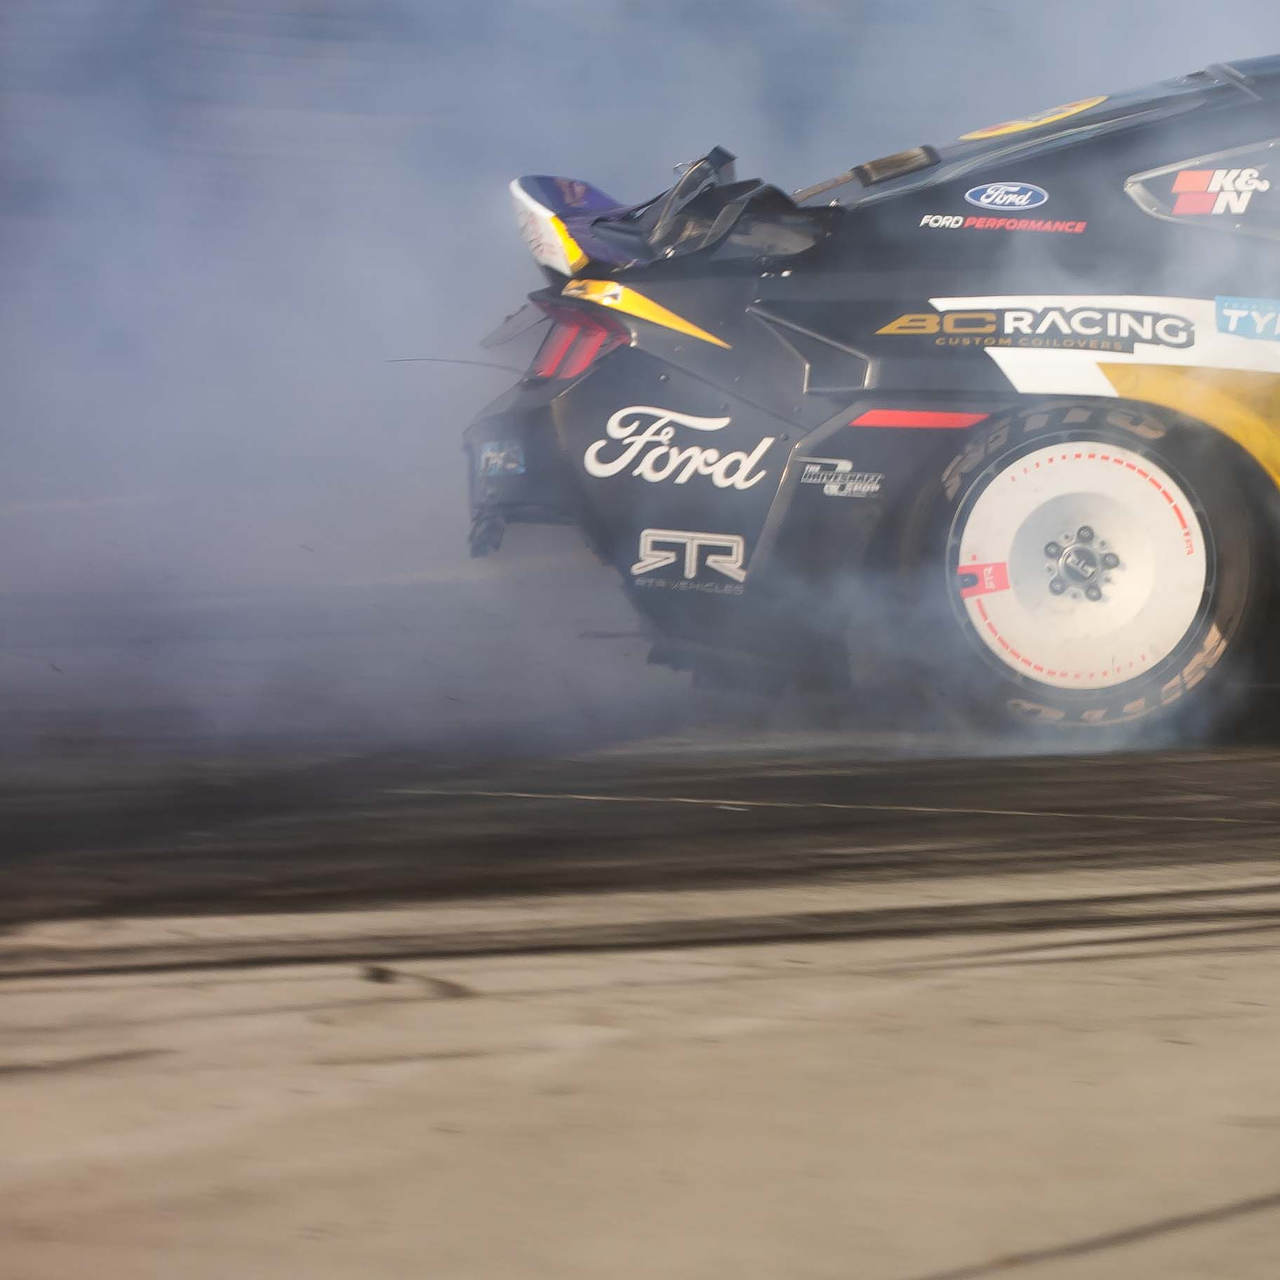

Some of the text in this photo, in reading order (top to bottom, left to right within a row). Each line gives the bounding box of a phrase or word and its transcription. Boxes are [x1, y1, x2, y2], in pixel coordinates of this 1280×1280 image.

[980, 185, 1034, 207] Ford
[919, 214, 1088, 234] FORD PERFORMANCE
[1003, 311, 1189, 344] RACING
[935, 336, 1012, 347] CUSTOM
[584, 405, 776, 491] Ford
